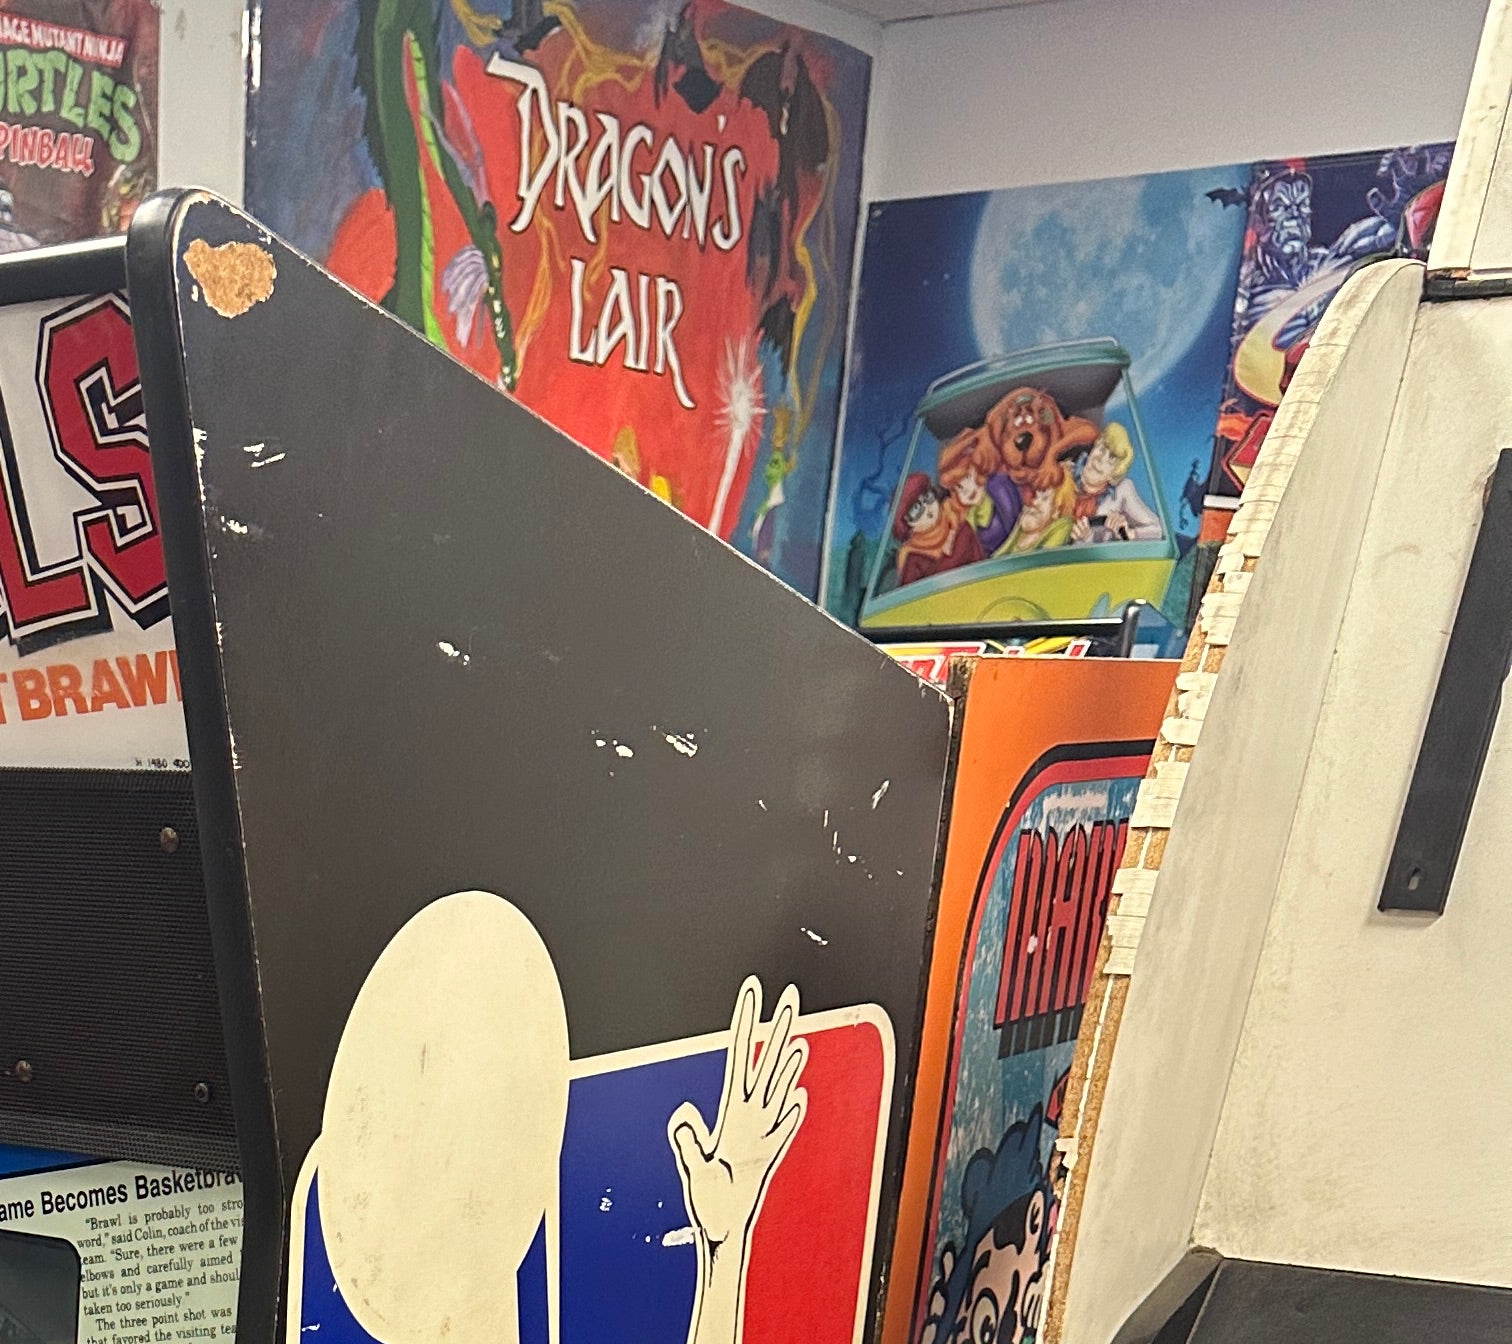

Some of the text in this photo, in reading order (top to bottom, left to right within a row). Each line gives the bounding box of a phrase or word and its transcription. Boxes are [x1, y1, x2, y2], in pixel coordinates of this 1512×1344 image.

[31, 24, 84, 55] MUTANT
[82, 34, 126, 63] NINJA
[485, 51, 748, 252] DRAGON'S
[568, 256, 697, 410] LAIR
[40, 1183, 129, 1216] Becomes
[128, 1214, 139, 1225] is
[144, 1201, 192, 1224] probably
[197, 1203, 215, 1217] too
[111, 1228, 133, 1244] said
[167, 1222, 198, 1238] coach
[199, 1217, 212, 1232] of
[211, 1217, 229, 1232] the
[147, 1243, 175, 1258] there
[178, 1241, 205, 1252] were
[218, 1234, 239, 1248] few
[80, 1250, 234, 1284] elbows and carefully aimed
[81, 1272, 208, 1299] but it's only game and
[83, 1300, 133, 1317] taken too
[95, 1307, 233, 1332] The three point shot was
[154, 1328, 174, 1343] the
[176, 1325, 218, 1341] visiting
